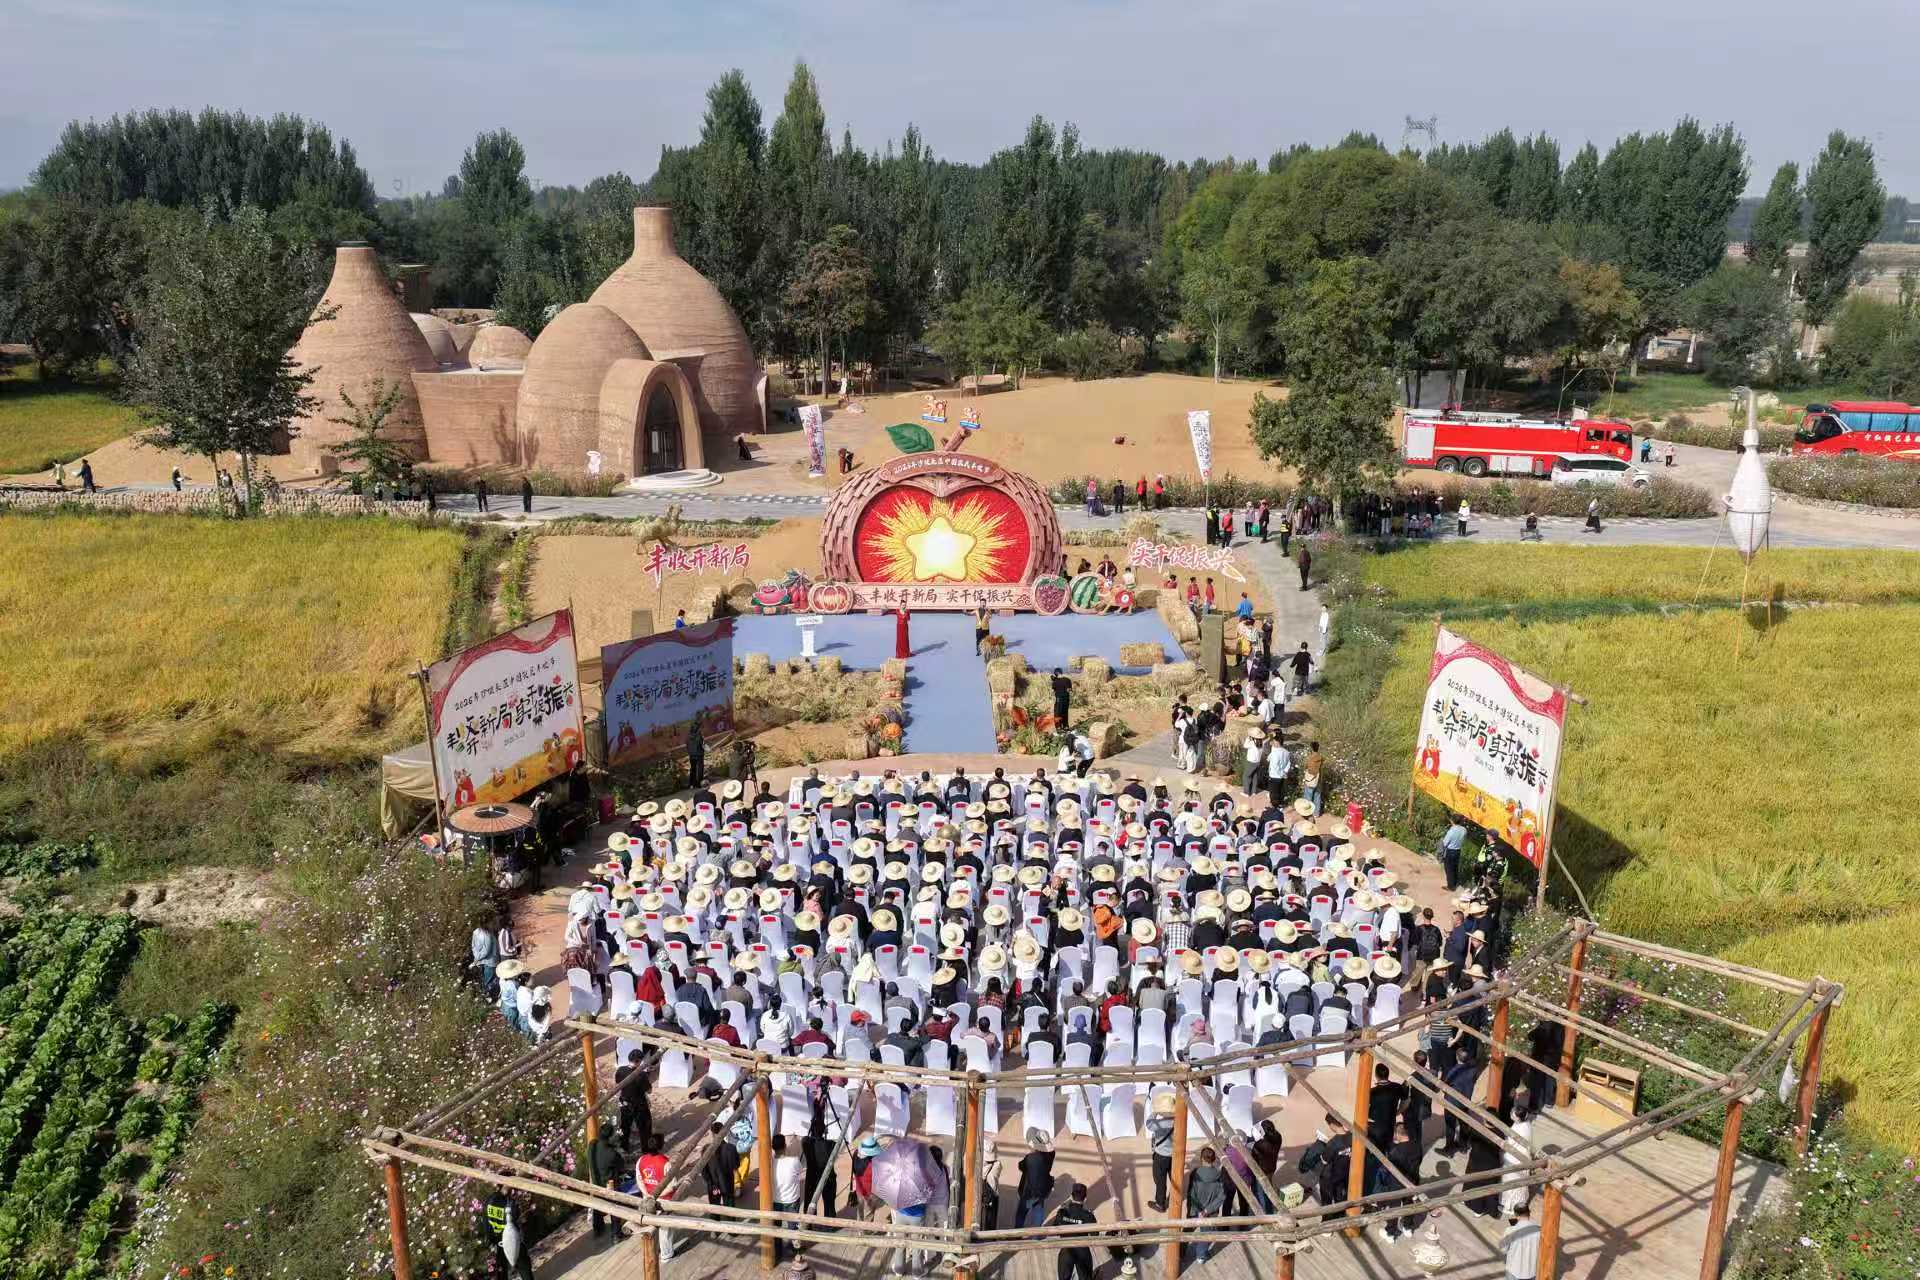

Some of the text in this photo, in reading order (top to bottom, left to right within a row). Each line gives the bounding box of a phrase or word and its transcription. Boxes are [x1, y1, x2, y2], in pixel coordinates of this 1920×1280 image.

[642, 543, 752, 586] 丰收开新局
[1130, 537, 1246, 583] 实干促振兴
[870, 588, 1014, 604] 丰收开新局 实干促振兴
[446, 681, 575, 757] 丰收开新局 实干促振兴
[1432, 698, 1549, 787] 丰收开新局 实干促振兴
